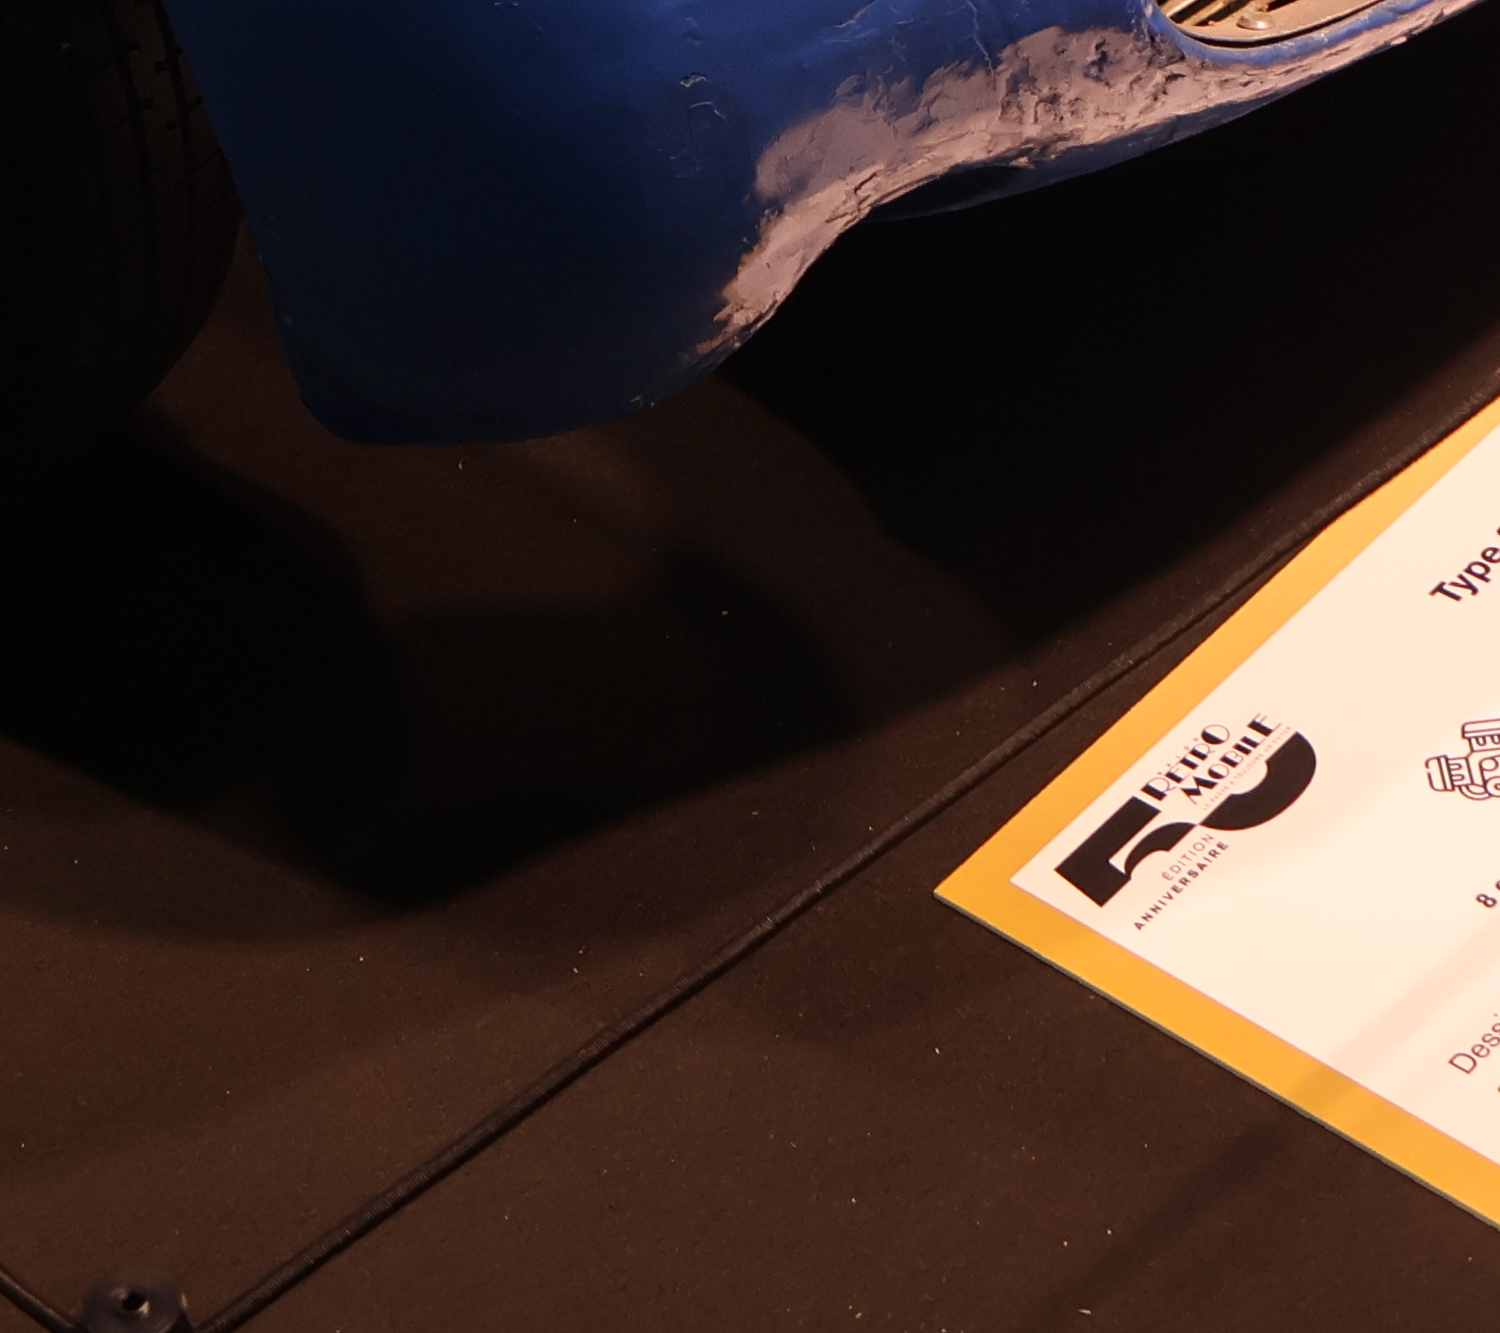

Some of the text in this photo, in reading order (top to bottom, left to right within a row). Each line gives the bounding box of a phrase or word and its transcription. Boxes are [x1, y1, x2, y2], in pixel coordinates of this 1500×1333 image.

[1161, 834, 1214, 881] ÉDITION
[1133, 841, 1229, 931] ANNIVERSAIRE
[1474, 891, 1499, 910] 8
